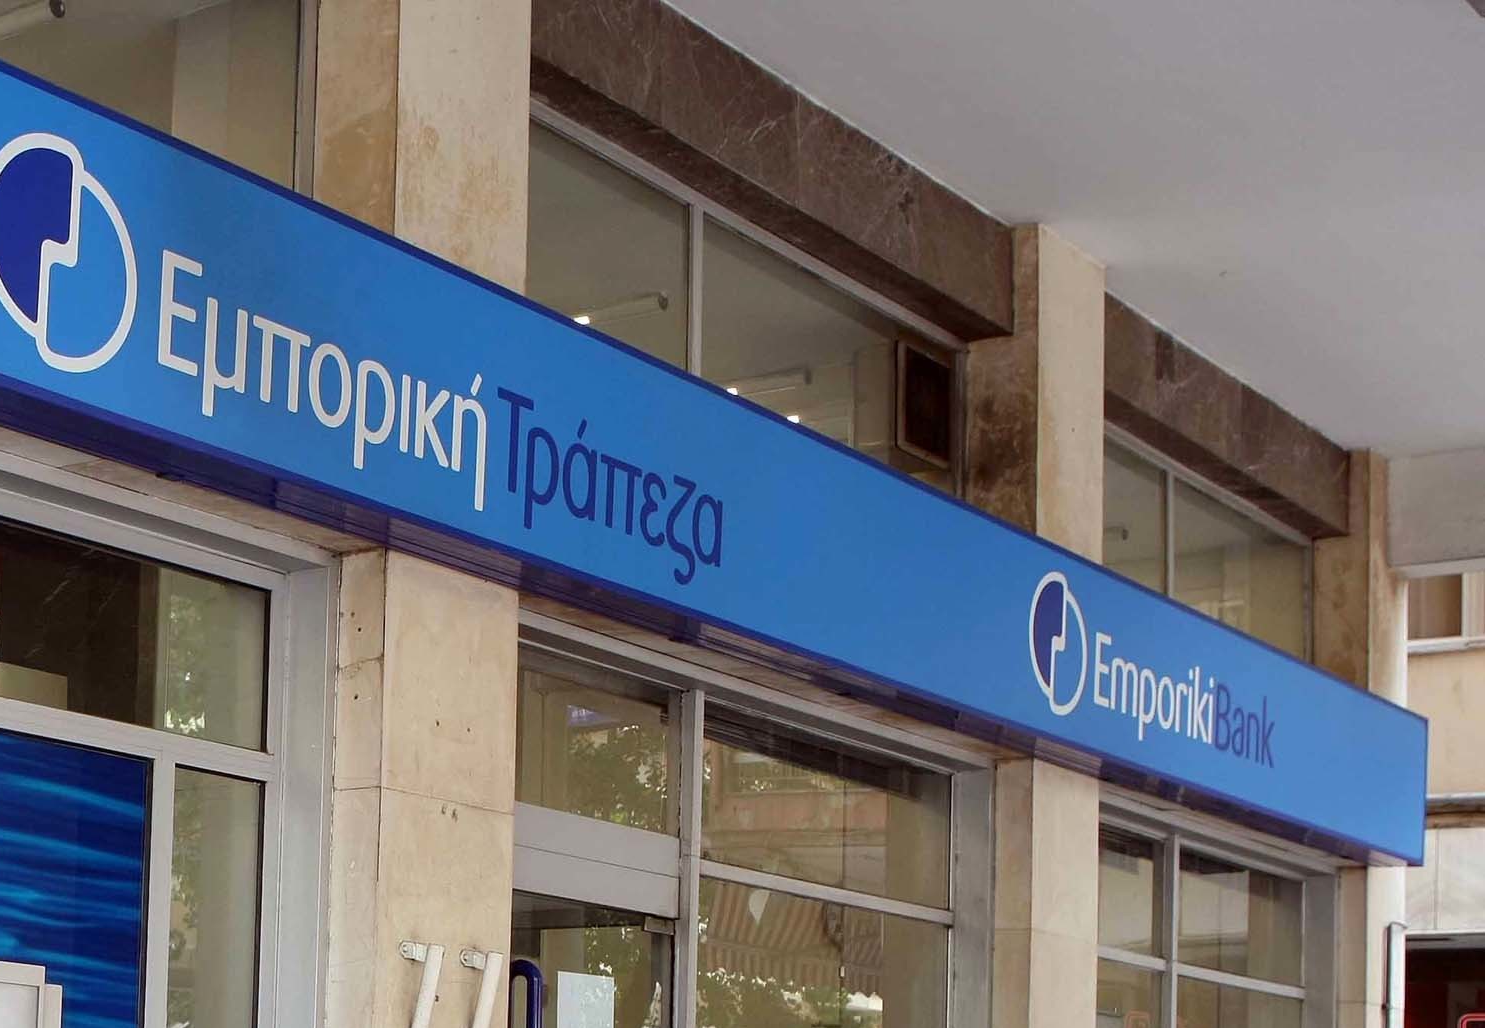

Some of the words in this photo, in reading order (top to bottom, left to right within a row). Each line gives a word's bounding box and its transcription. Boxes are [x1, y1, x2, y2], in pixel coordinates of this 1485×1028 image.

[157, 248, 487, 512] Εμπορική
[497, 386, 723, 586] Τράπεζα
[1093, 631, 1215, 744] Emporiki
[1215, 683, 1275, 768] Bank
